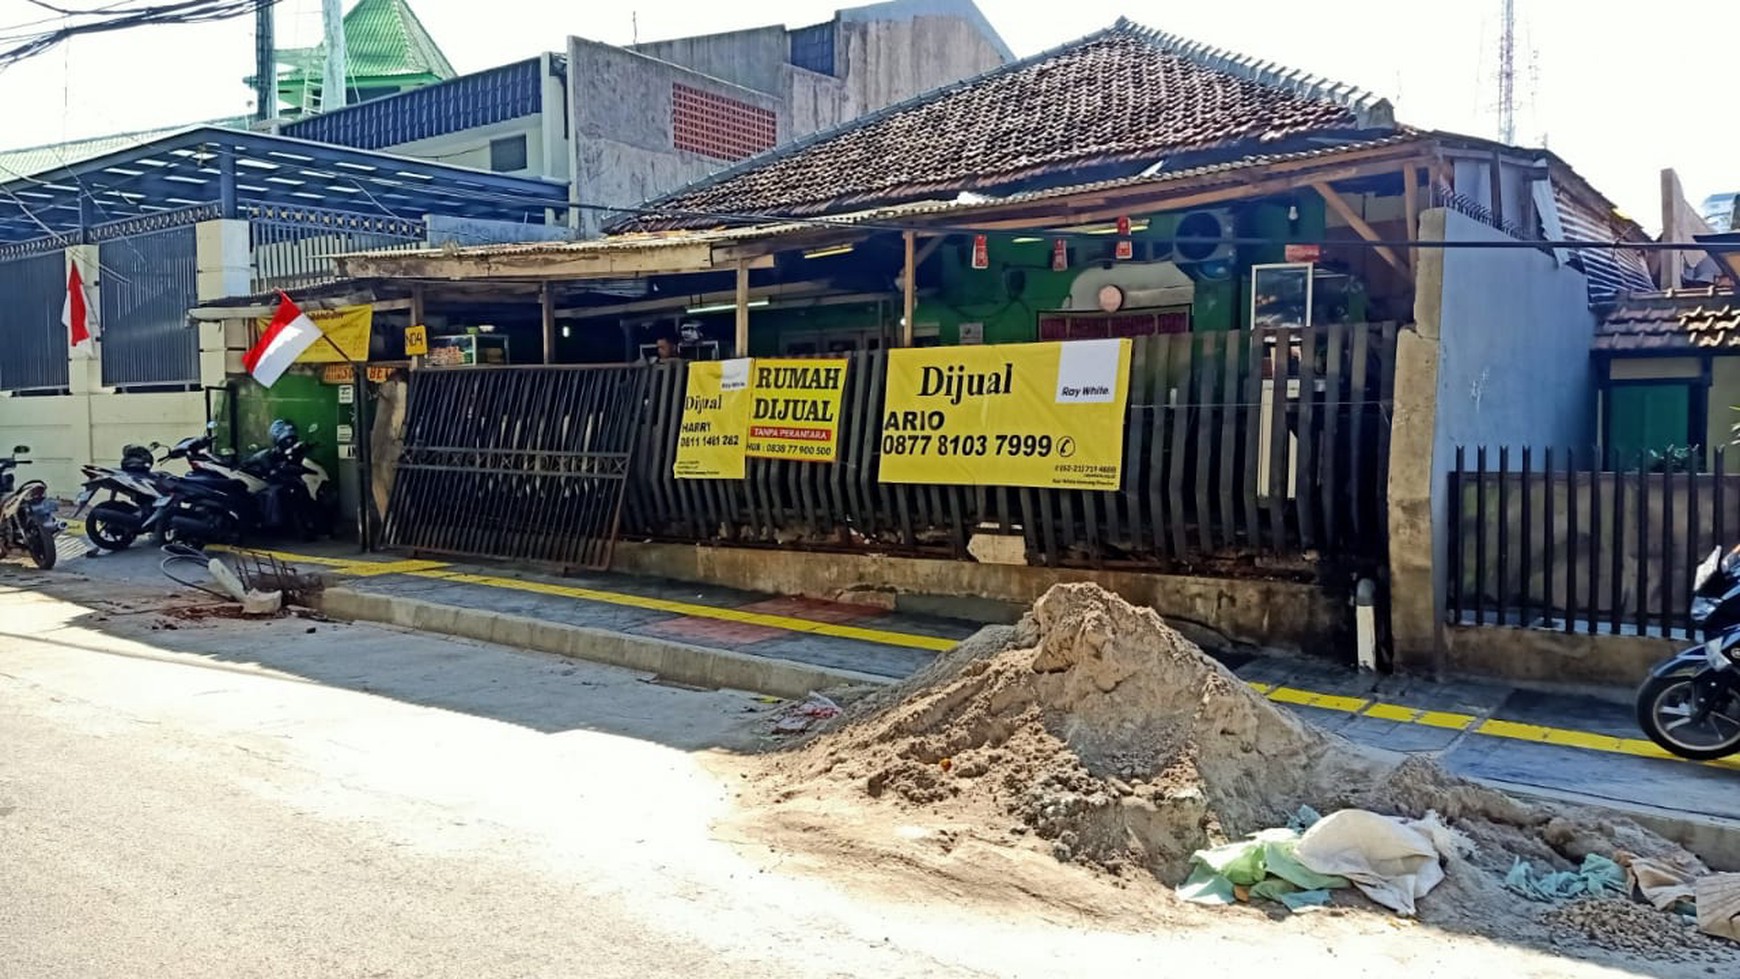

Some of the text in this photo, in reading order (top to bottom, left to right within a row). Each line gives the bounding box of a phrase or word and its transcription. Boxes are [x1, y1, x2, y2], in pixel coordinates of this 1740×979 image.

[756, 367, 841, 390] RUMAH
[917, 363, 1013, 405] Dijual
[1061, 386, 1081, 398] Ray
[753, 398, 834, 422] DIJUAL
[884, 411, 945, 431] ARIO
[754, 428, 827, 440] TANPA PERANTARA
[787, 445, 798, 454] 77
[816, 446, 831, 455] 500
[882, 434, 1051, 457] 0877 8103 7999
